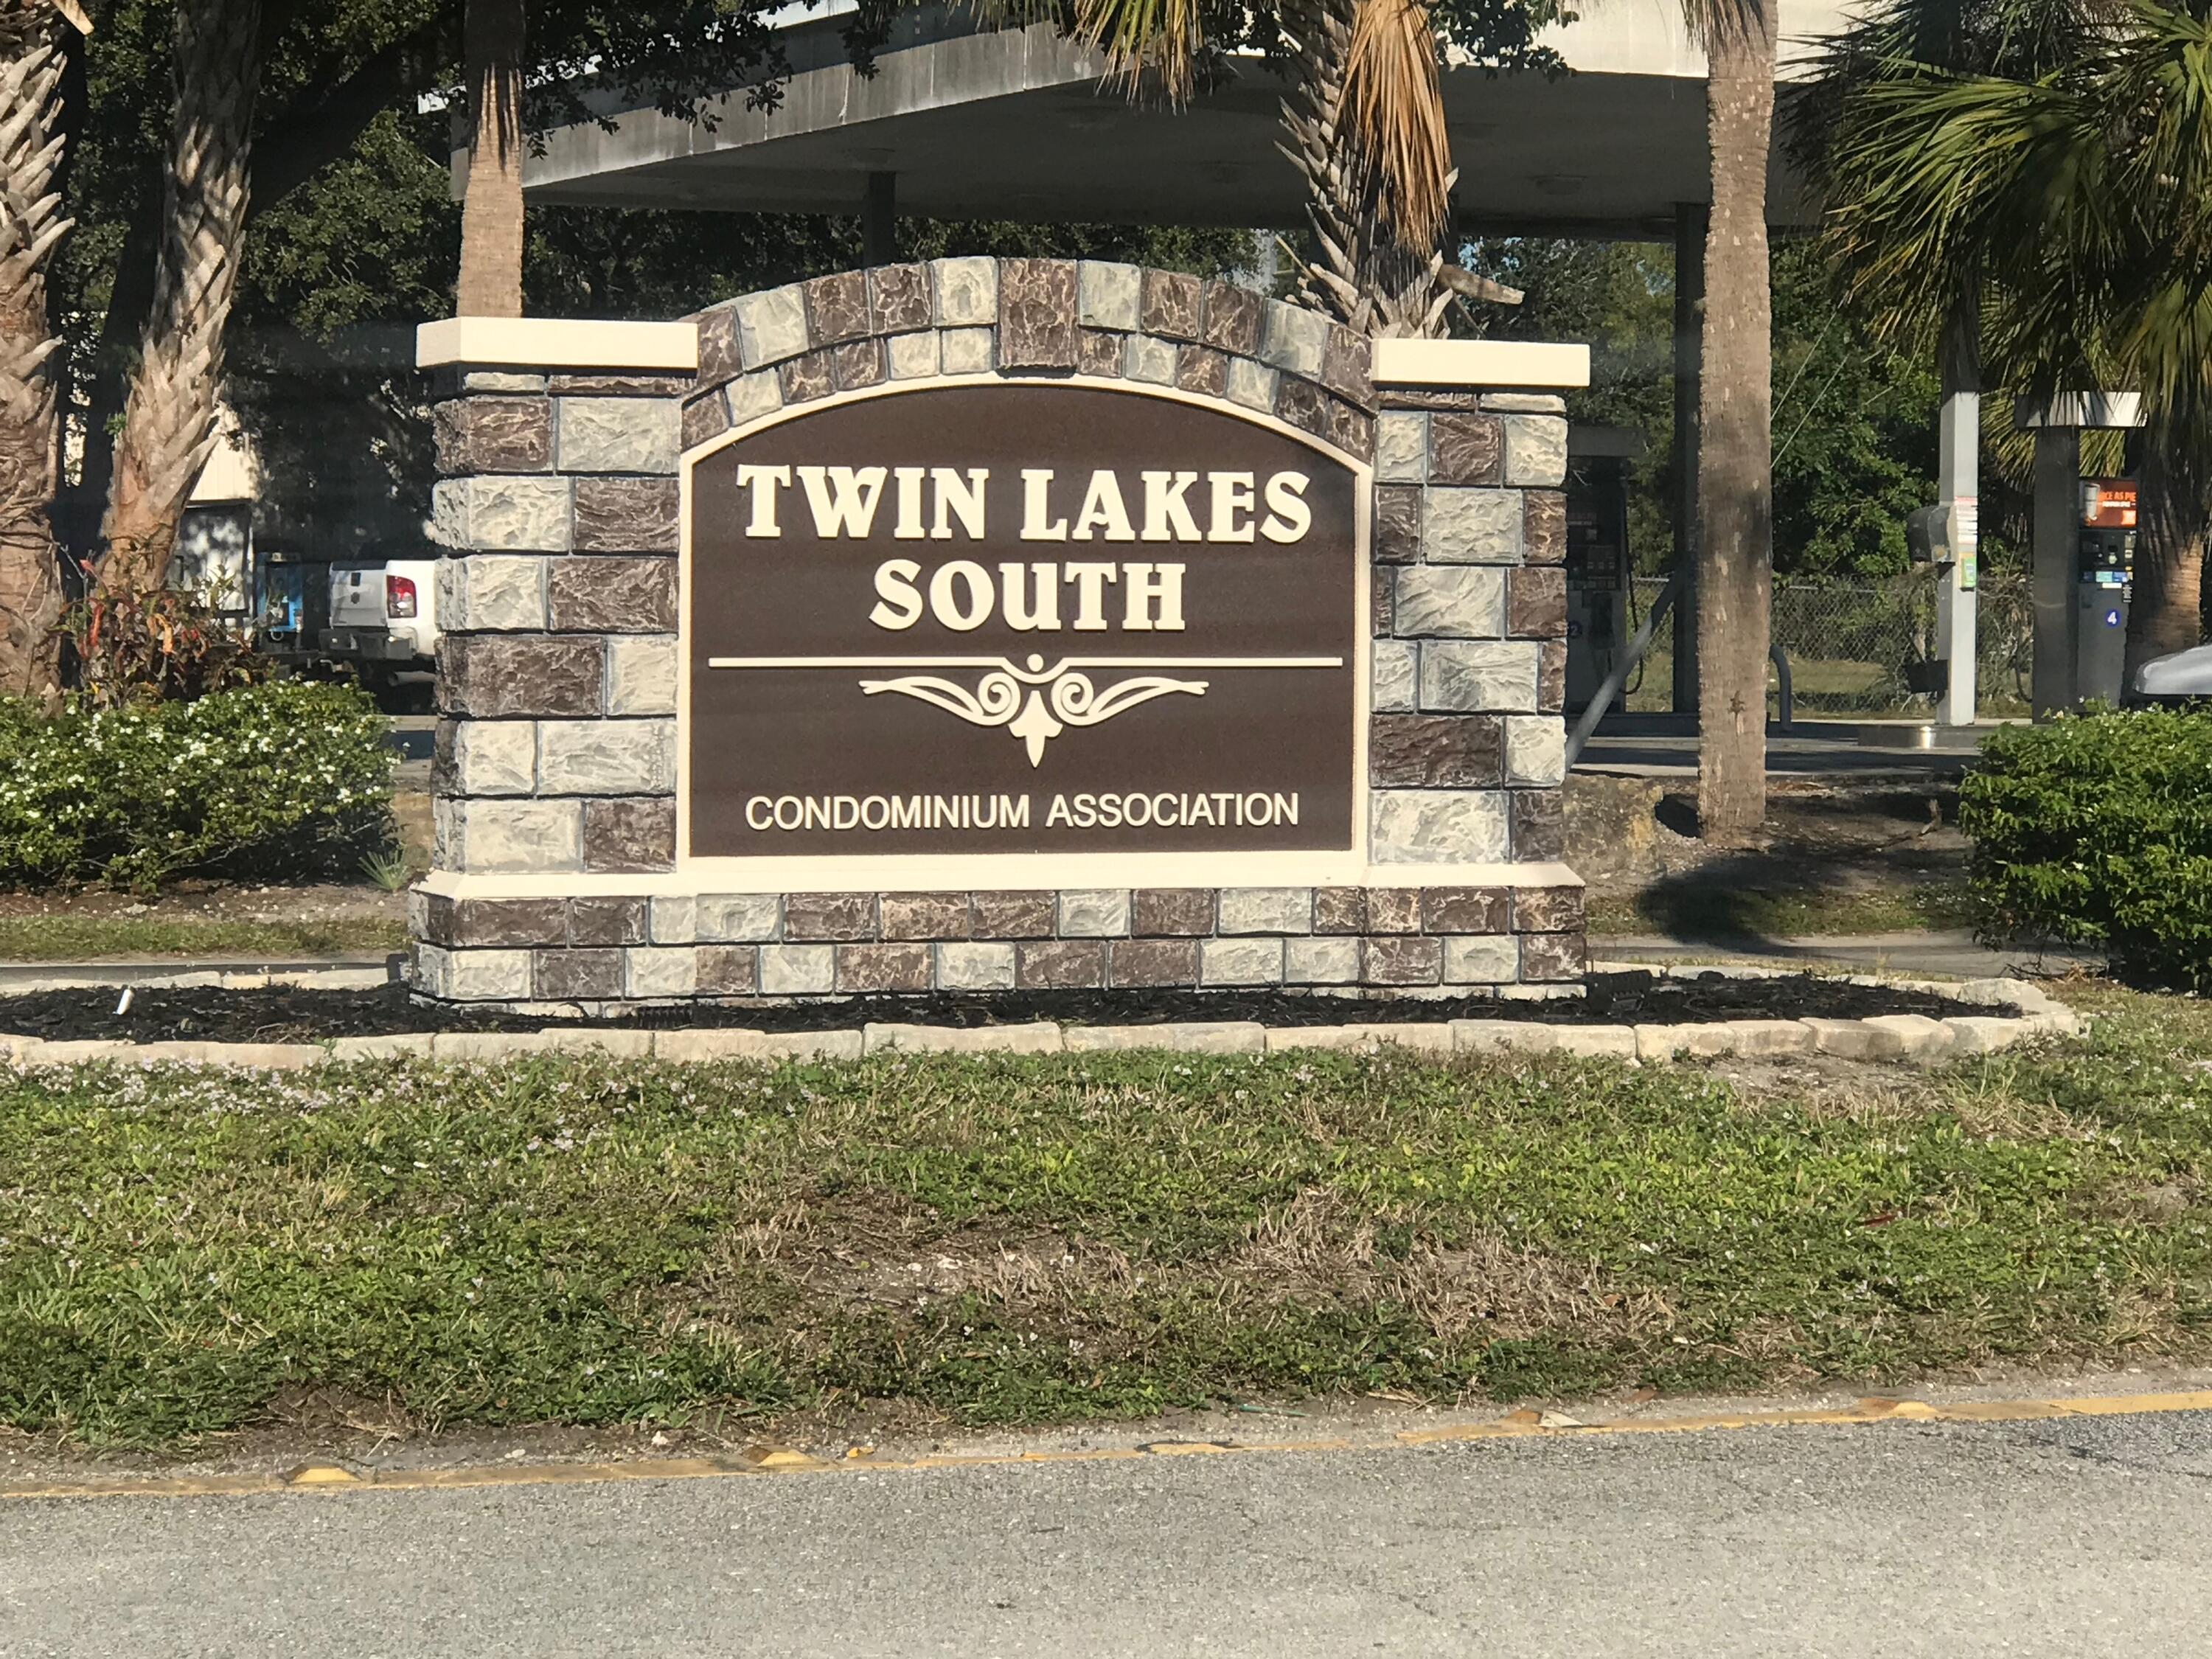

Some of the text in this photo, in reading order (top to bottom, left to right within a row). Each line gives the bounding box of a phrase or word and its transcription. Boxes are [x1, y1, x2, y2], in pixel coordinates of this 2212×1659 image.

[737, 465, 1311, 543] TWIN LAKES
[869, 560, 1186, 630] SOUTH
[2107, 611, 2118, 625] 4
[746, 793, 1298, 830] CONDOMINIUM ASSOCIATION
